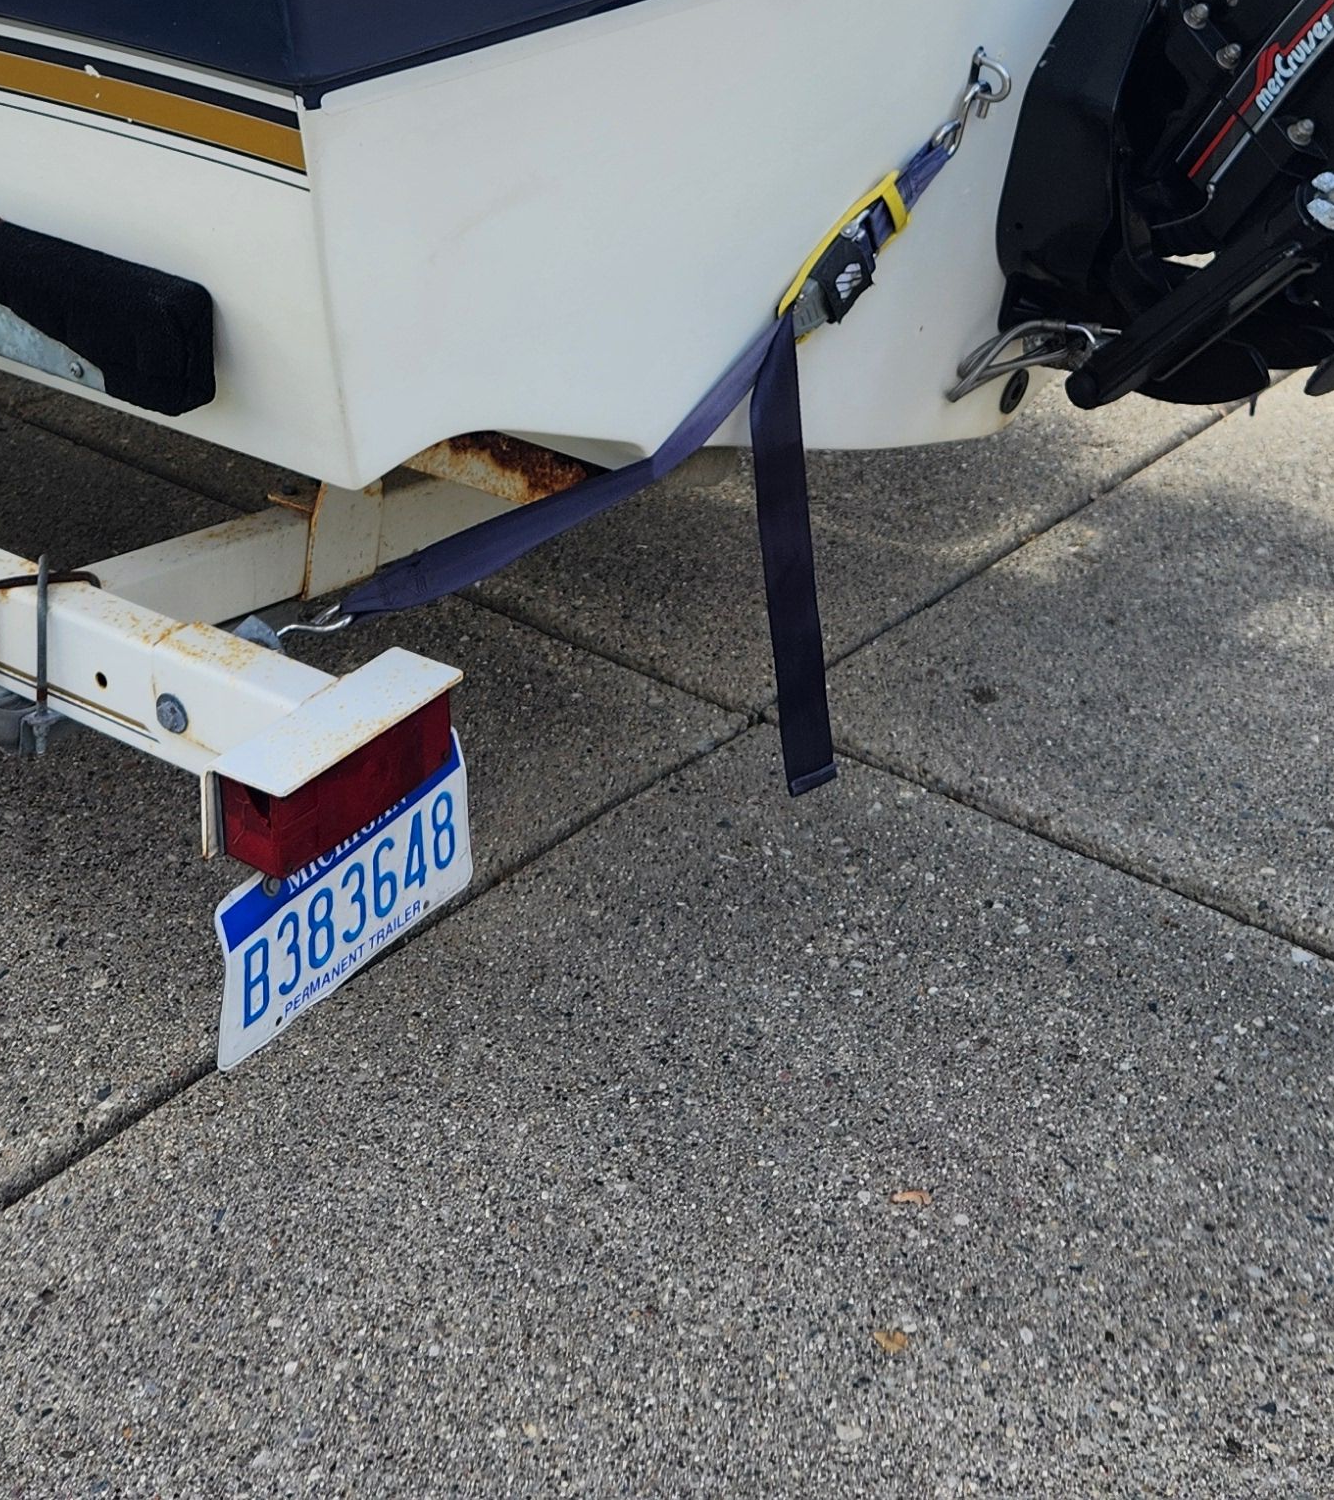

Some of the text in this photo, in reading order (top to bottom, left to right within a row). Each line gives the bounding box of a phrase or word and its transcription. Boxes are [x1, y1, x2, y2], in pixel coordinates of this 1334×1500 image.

[1255, 13, 1333, 113] merCruiser
[243, 790, 456, 1030] B383648
[283, 899, 421, 1020] PERMANENT TRAILER
